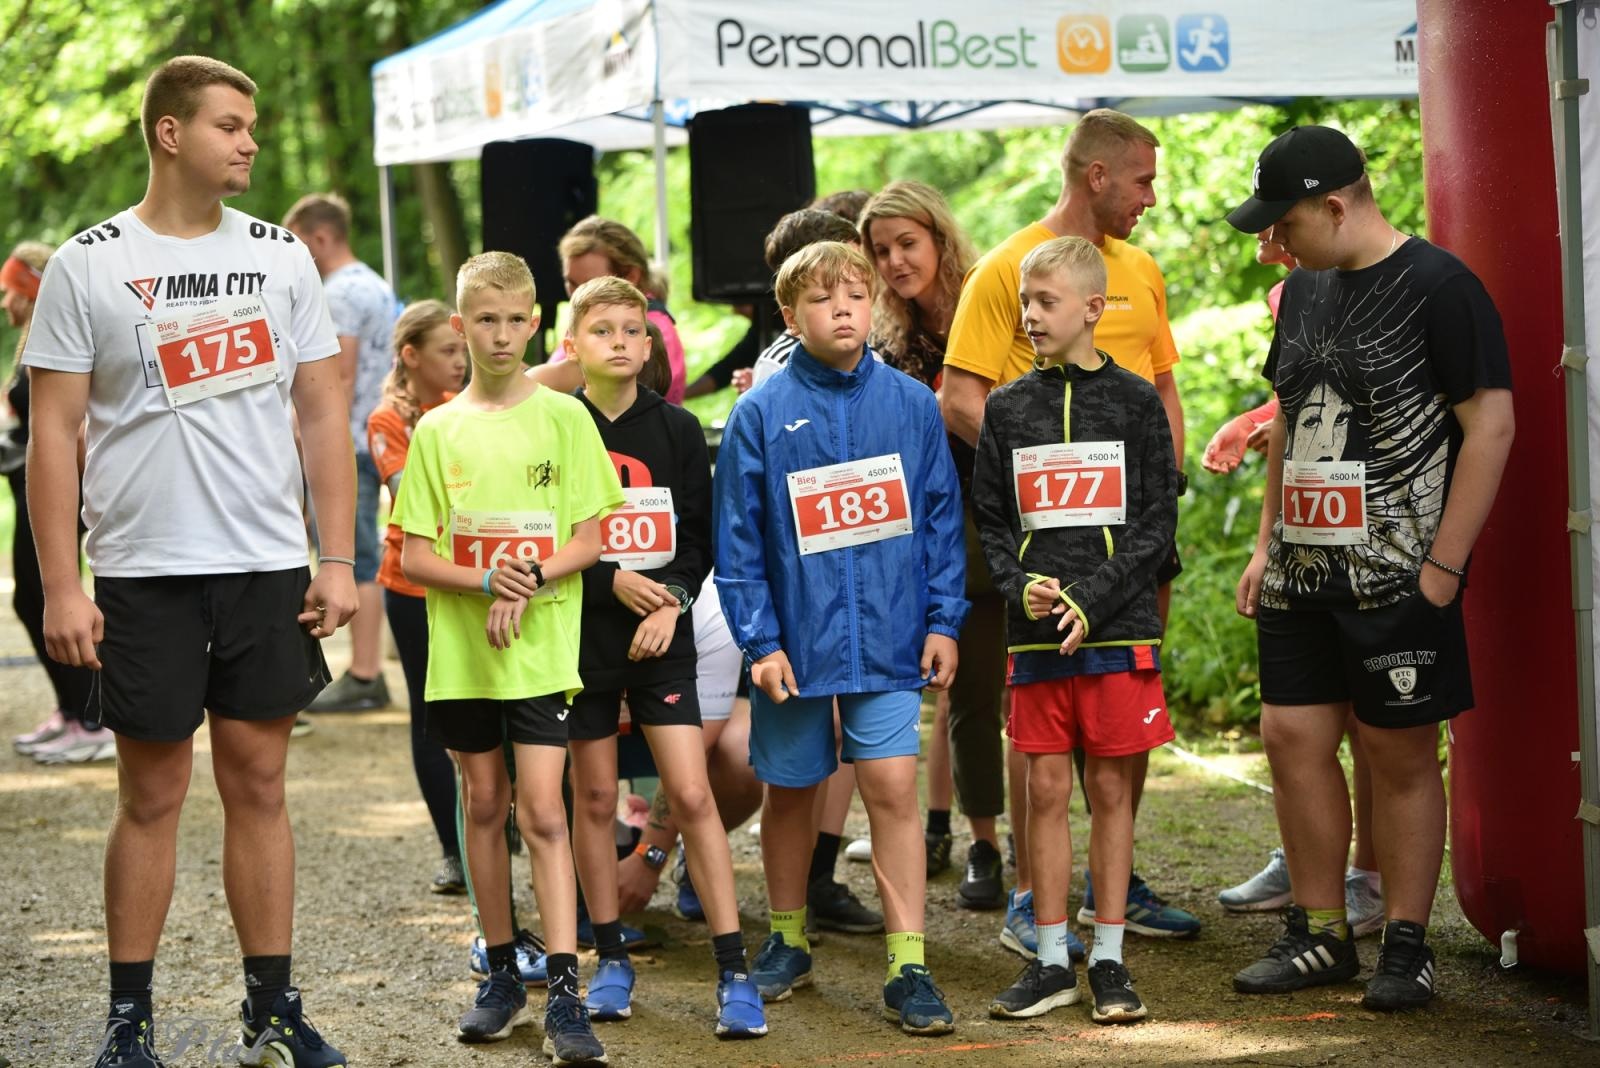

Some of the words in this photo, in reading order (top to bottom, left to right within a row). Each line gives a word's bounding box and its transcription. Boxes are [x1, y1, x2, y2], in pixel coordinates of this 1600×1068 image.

[717, 18, 1037, 68] PersonalBest
[166, 273, 218, 300] MMA
[226, 271, 267, 295] CITY
[233, 307, 253, 318] 4500
[253, 304, 261, 313] M
[157, 320, 179, 333] Bieg
[180, 326, 258, 379] 175
[1021, 453, 1037, 462] Bieg
[1088, 453, 1109, 461] 4500
[868, 467, 889, 477] 4500
[1329, 473, 1350, 481] 4500
[797, 475, 817, 485] Bieg
[1033, 470, 1104, 508] 177
[816, 486, 890, 530] 183
[1290, 490, 1346, 525] 170
[457, 515, 472, 526] Bieg
[524, 523, 543, 531] 4500
[601, 516, 657, 551] 80
[1363, 650, 1437, 672] BROOKLYN
